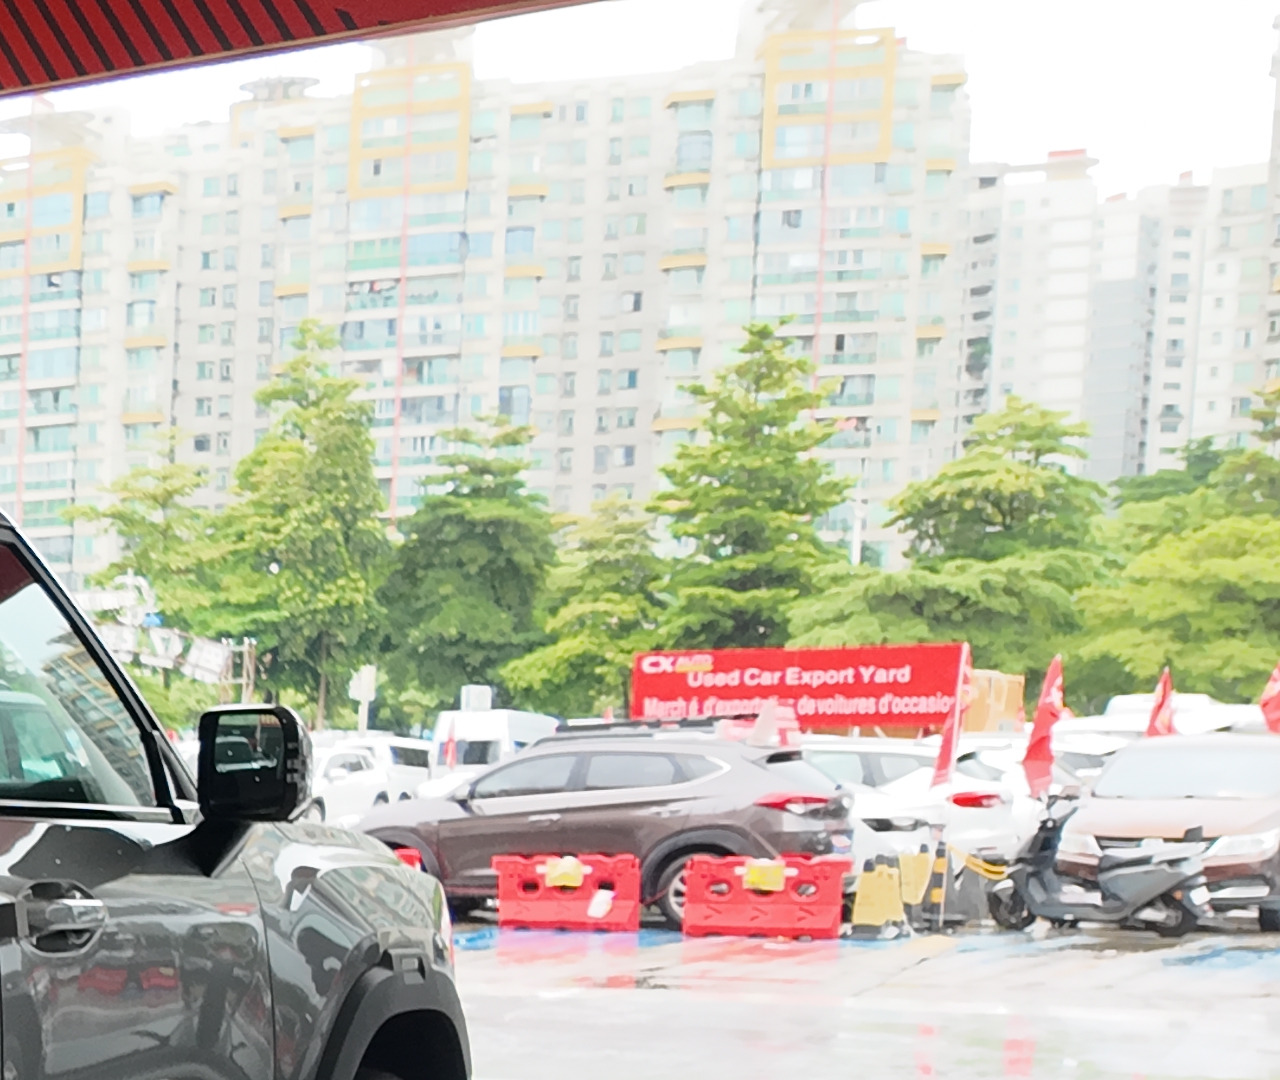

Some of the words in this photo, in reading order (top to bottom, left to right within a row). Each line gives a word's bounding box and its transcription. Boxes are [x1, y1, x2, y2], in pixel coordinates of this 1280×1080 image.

[641, 656, 675, 674] CX
[687, 669, 740, 688] Used
[743, 668, 783, 687] Car
[785, 666, 855, 688] Export
[859, 664, 912, 685] Yard
[797, 694, 816, 715] de
[818, 694, 876, 714] voitures
